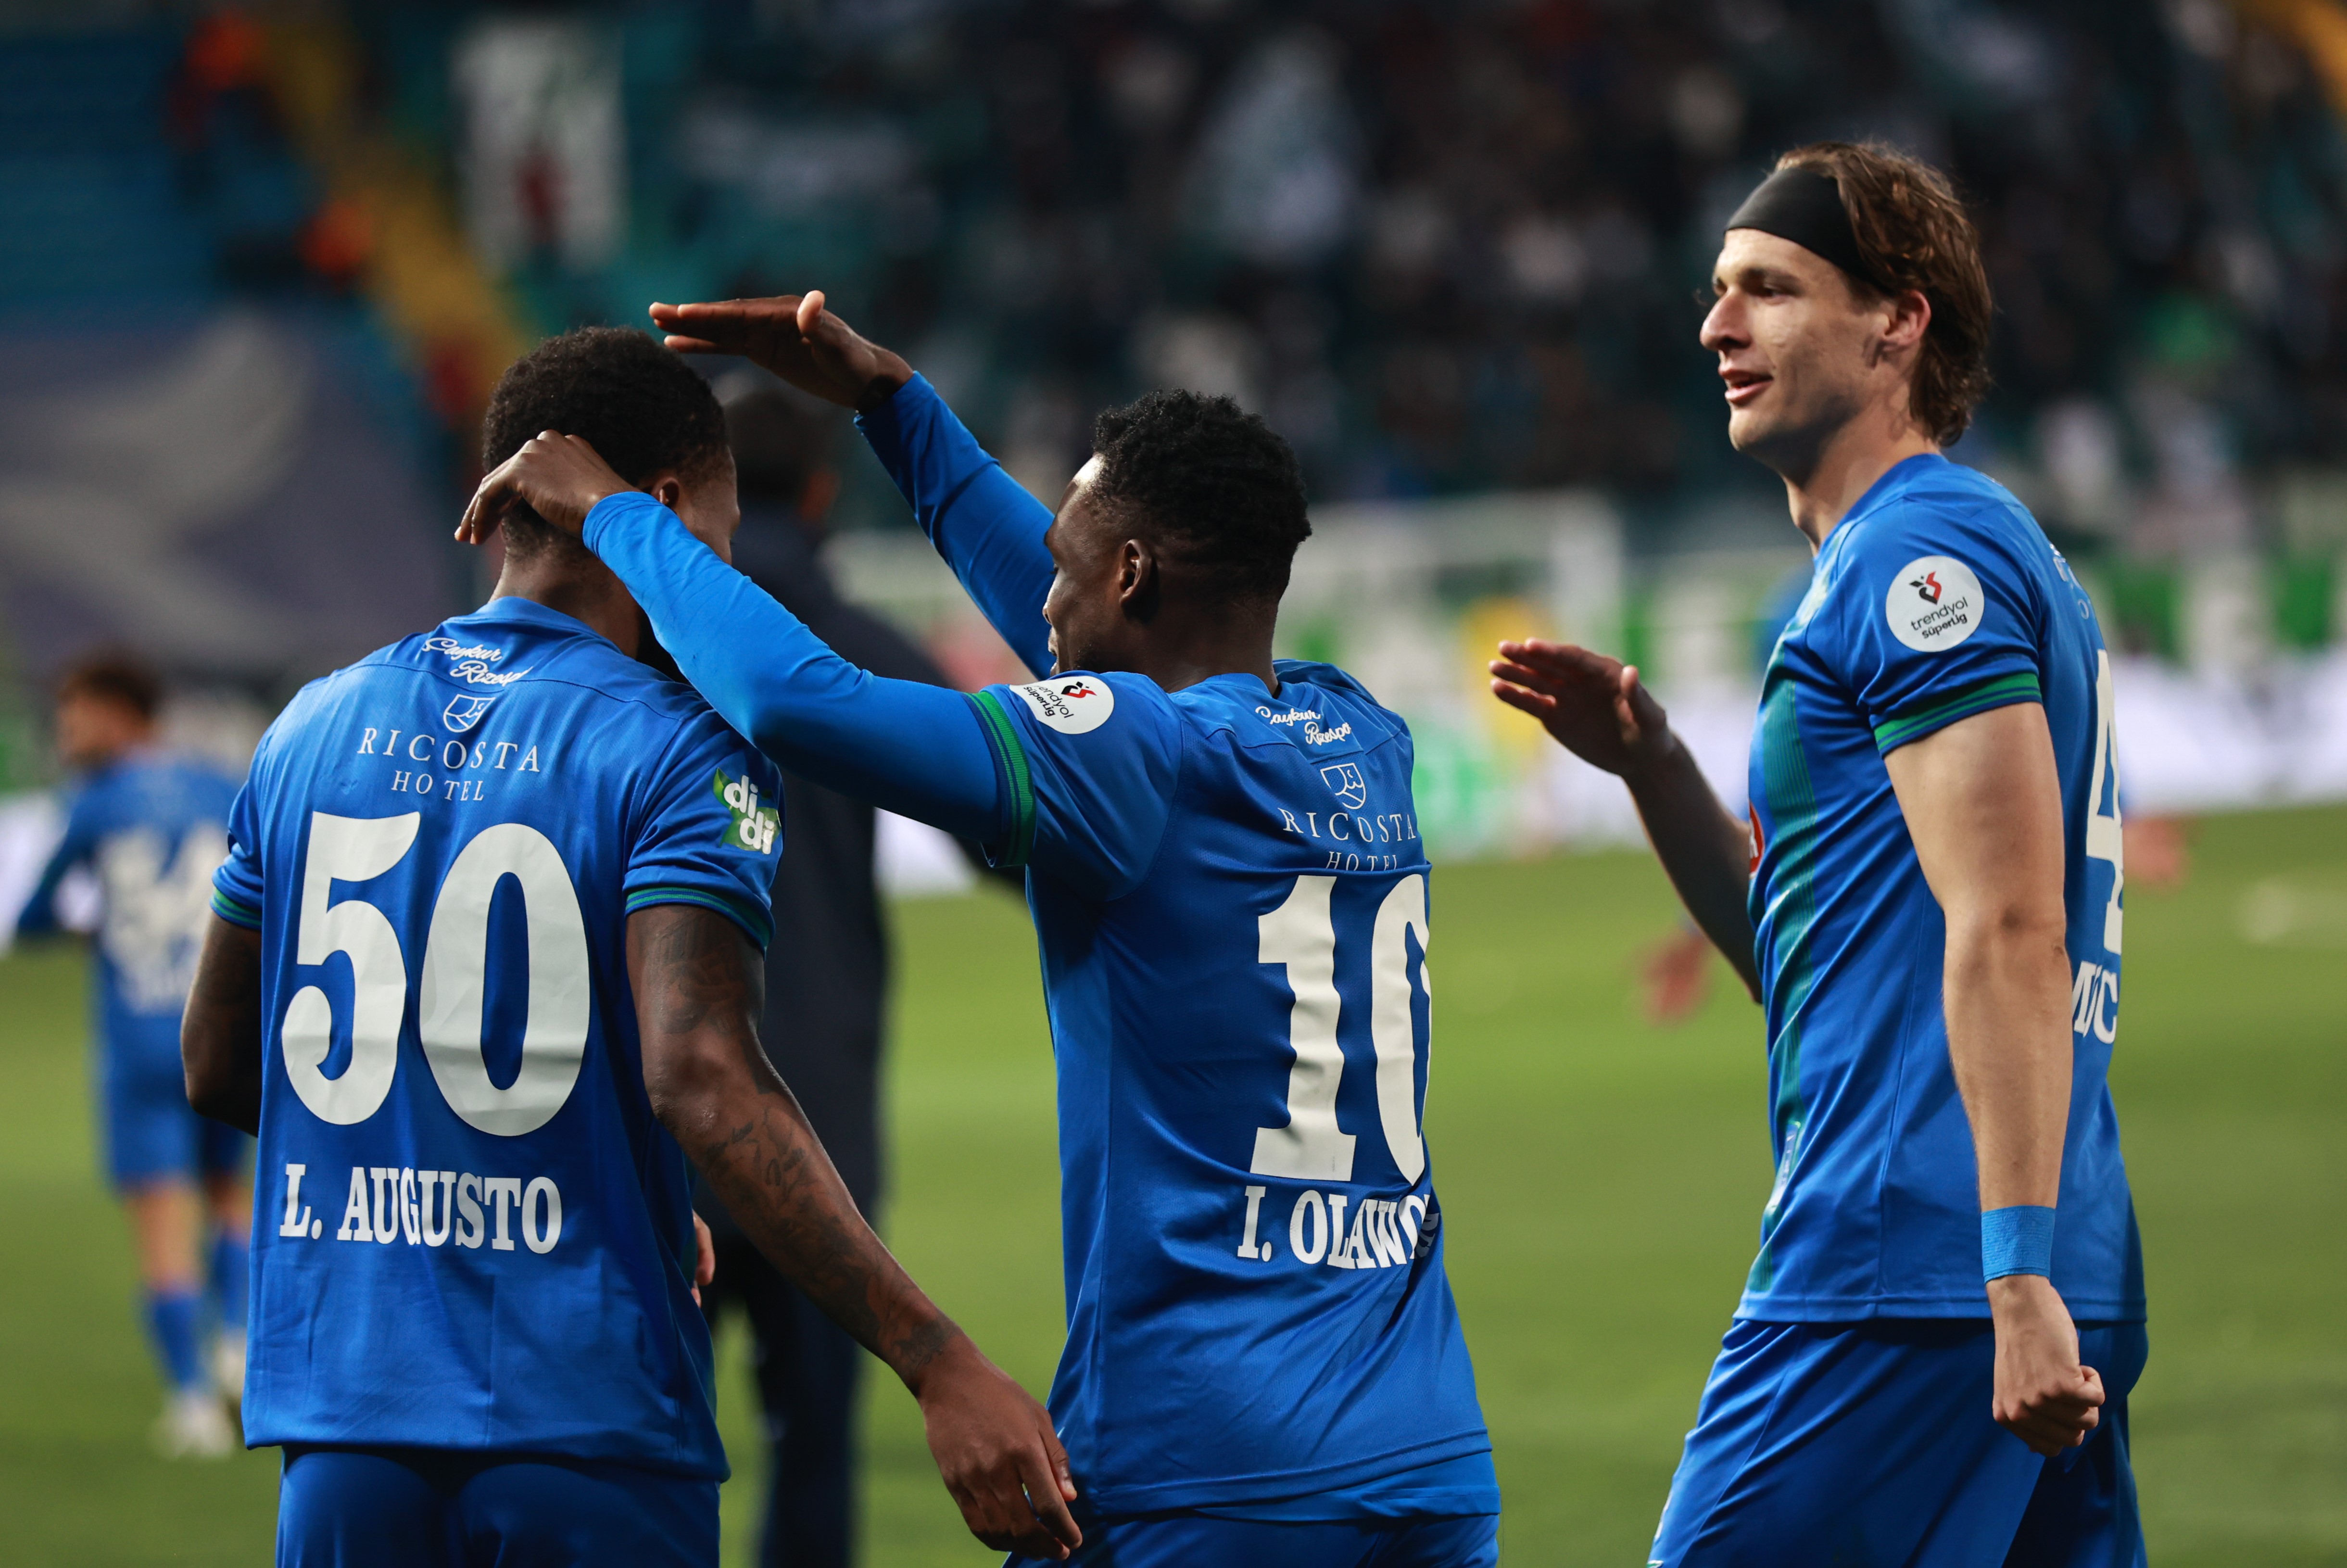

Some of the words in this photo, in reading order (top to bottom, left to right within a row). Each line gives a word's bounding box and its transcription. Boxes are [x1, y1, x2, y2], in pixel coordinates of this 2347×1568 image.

[1911, 596, 1968, 631] trendyol
[450, 660, 533, 687] Rizesp
[357, 727, 540, 772] RICOSTA
[391, 770, 484, 801] HOTEL
[724, 775, 758, 819] di
[740, 811, 775, 855] di
[1277, 808, 1416, 843] RICOSTA
[281, 810, 590, 1137] 50
[1250, 874, 1432, 1186] 10
[279, 1163, 323, 1240] L.
[337, 1166, 562, 1254] AUGUSTO
[1237, 1185, 1272, 1262] I.
[1289, 1189, 1430, 1269] OLAWO
